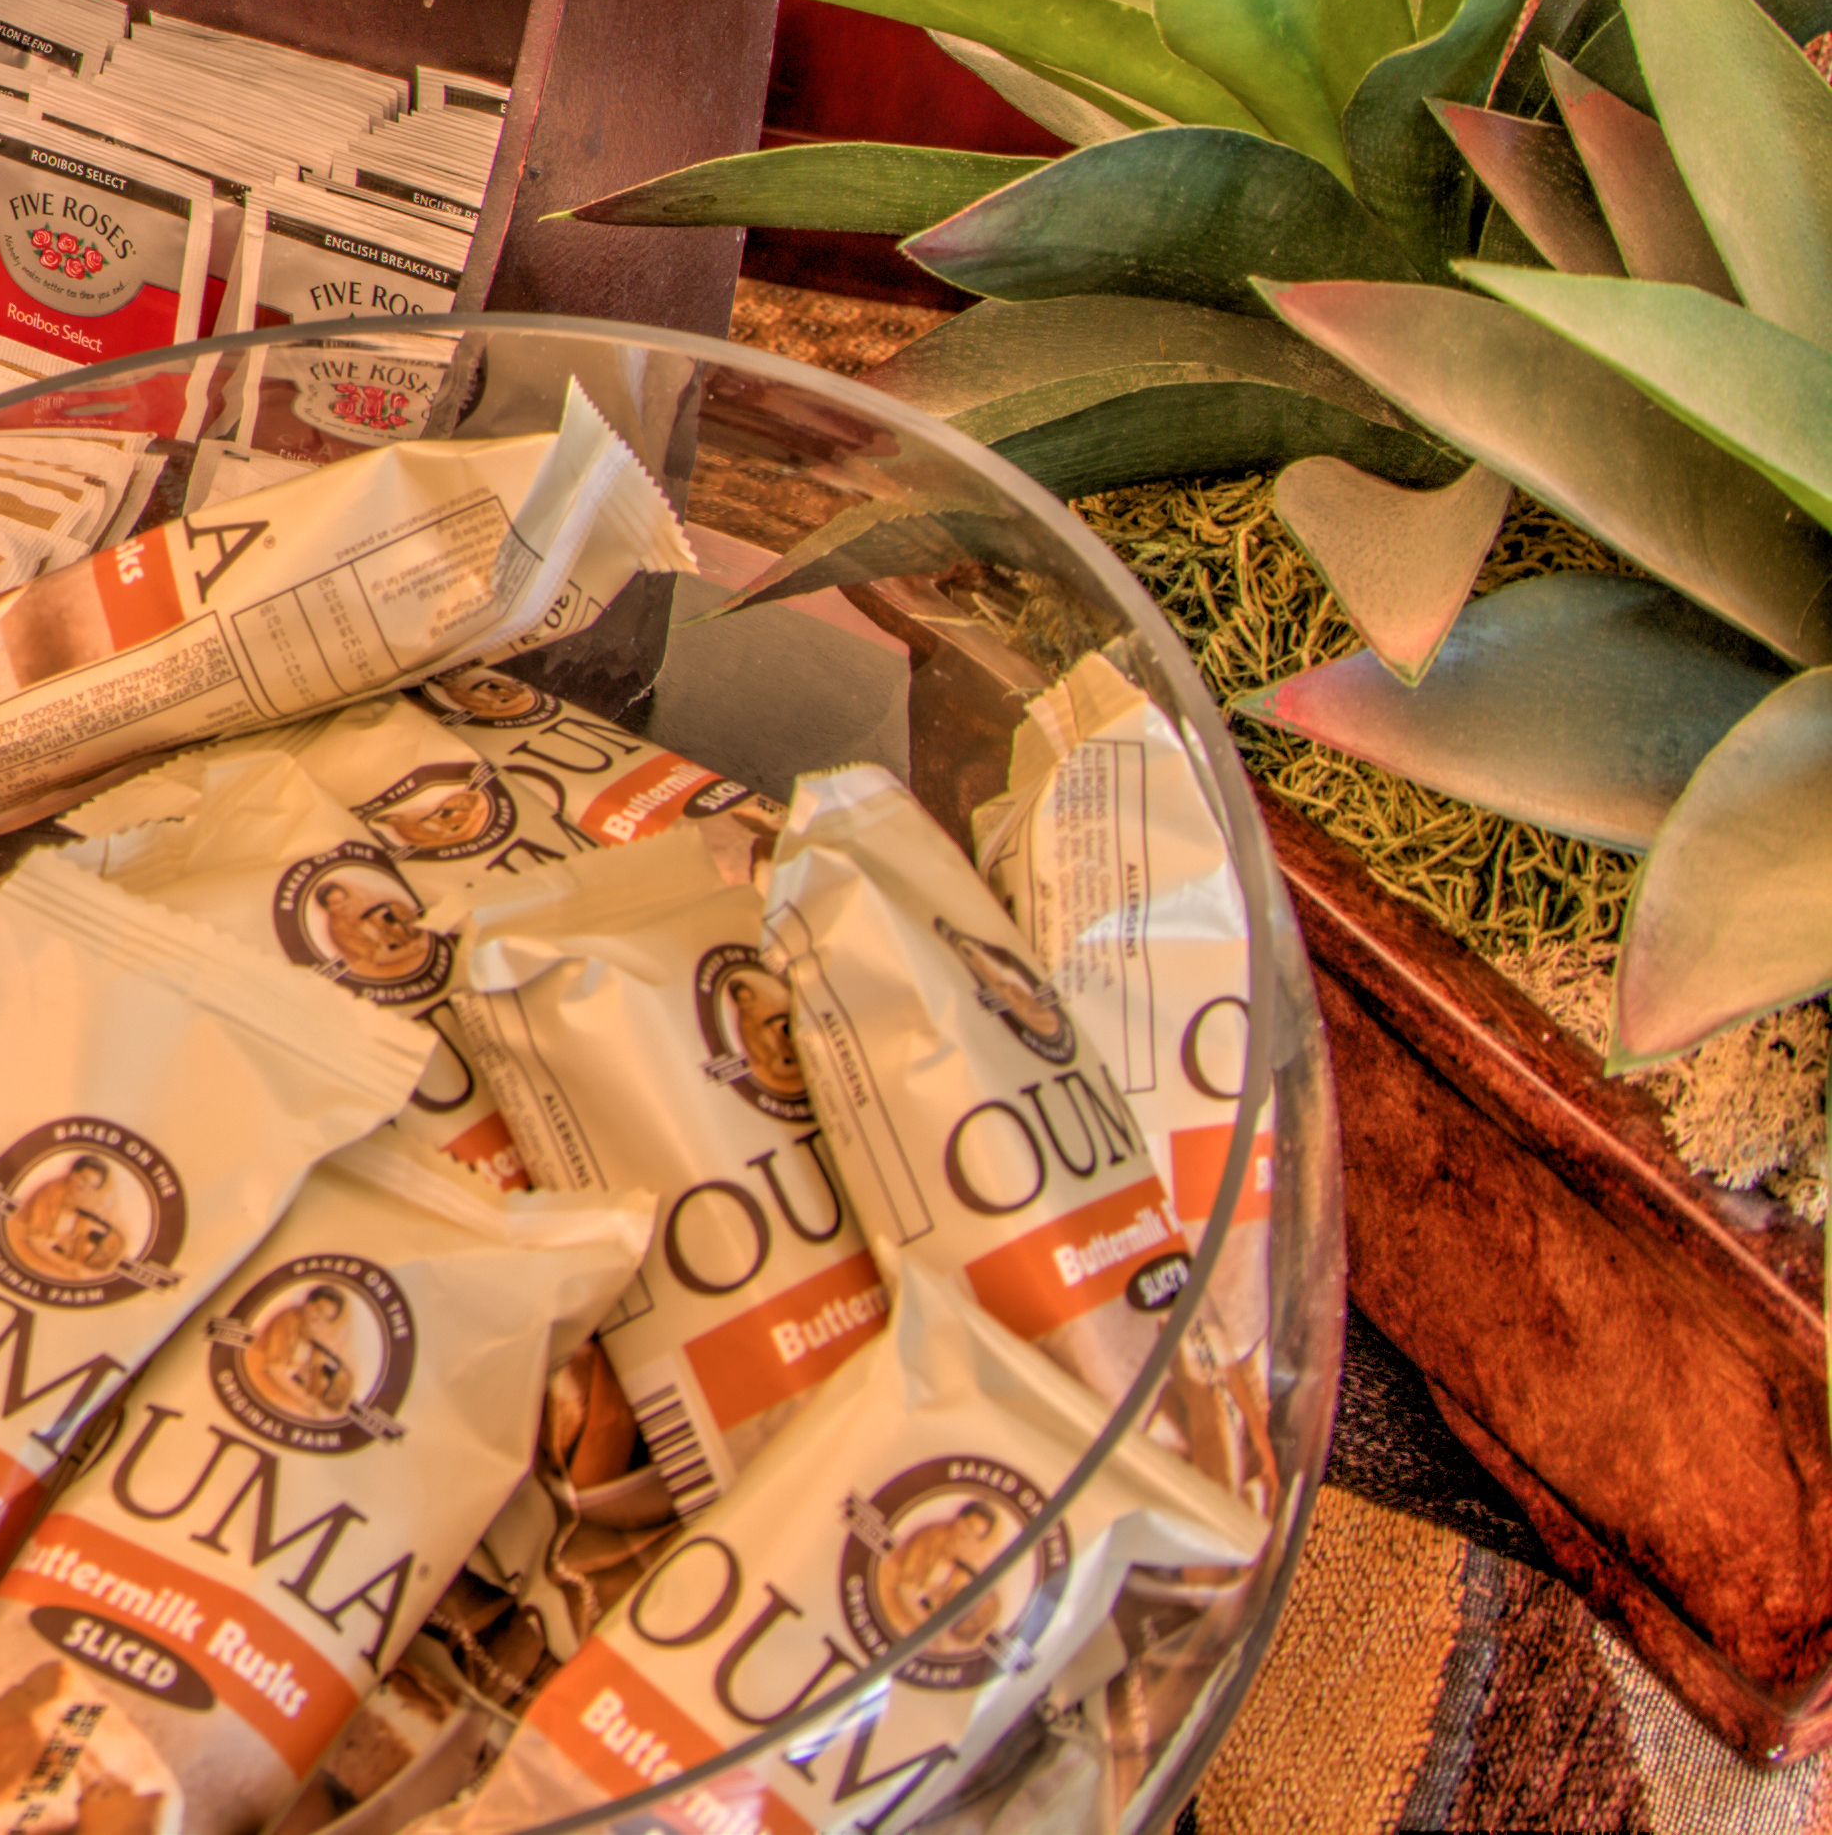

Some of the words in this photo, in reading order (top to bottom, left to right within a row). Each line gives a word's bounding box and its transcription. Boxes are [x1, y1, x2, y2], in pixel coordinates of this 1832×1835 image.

[22, 34, 53, 54] BLEND
[31, 149, 84, 176] ROOIBOS
[86, 168, 128, 190] SELECT
[9, 192, 54, 220] FIVE
[63, 196, 134, 259] ROSES
[325, 235, 378, 260] ENGLISH
[381, 252, 450, 283] BREAKFAST
[310, 281, 362, 310] FIVE
[7, 303, 60, 336] Rooibos
[62, 325, 103, 353] Select
[375, 529, 389, 540] as
[390, 502, 448, 534] information
[141, 653, 204, 687] CONVIENT
[202, 666, 233, 686] NOT
[206, 656, 227, 670] NIE
[90, 690, 116, 708] AUX
[96, 694, 140, 717] MENSE
[118, 681, 141, 697] PAS
[147, 679, 204, 709] SUITABLE
[17, 702, 89, 736] PERSONNES
[20, 695, 74, 723] PESSOAS
[69, 711, 95, 728] MET
[122, 703, 147, 720] FOR
[43, 731, 75, 750] WITH
[74, 714, 120, 739] PEOPLE
[388, 778, 415, 799] THE
[438, 825, 504, 858] ORIGINAL
[281, 863, 312, 911] BAKED
[314, 851, 339, 864] ON
[345, 845, 374, 860] THE
[1123, 862, 1141, 958] ALLERGENS
[362, 978, 434, 1000] ORIGINAL
[821, 1010, 870, 1109] ALLERGENS
[543, 1093, 593, 1191] ALLERGENS
[945, 1065, 1146, 1217] OUM
[54, 1123, 122, 1146] BAKED
[125, 1140, 154, 1166] ON
[151, 1166, 177, 1199] THE
[664, 1129, 841, 1296] OU
[1053, 1207, 1169, 1287] Buttermilk
[48, 1287, 104, 1304] FARM
[293, 1258, 361, 1275] BAKED
[365, 1270, 392, 1299] ON
[388, 1302, 409, 1339] THE
[218, 1369, 283, 1438] ORIGINAL
[291, 1431, 341, 1448] FARM
[948, 1461, 1018, 1493] BAKED
[112, 1403, 416, 1674] UMA
[24, 1544, 206, 1642] uttermilk
[207, 1619, 307, 1718] Rusks
[64, 1619, 177, 1690] SLICED
